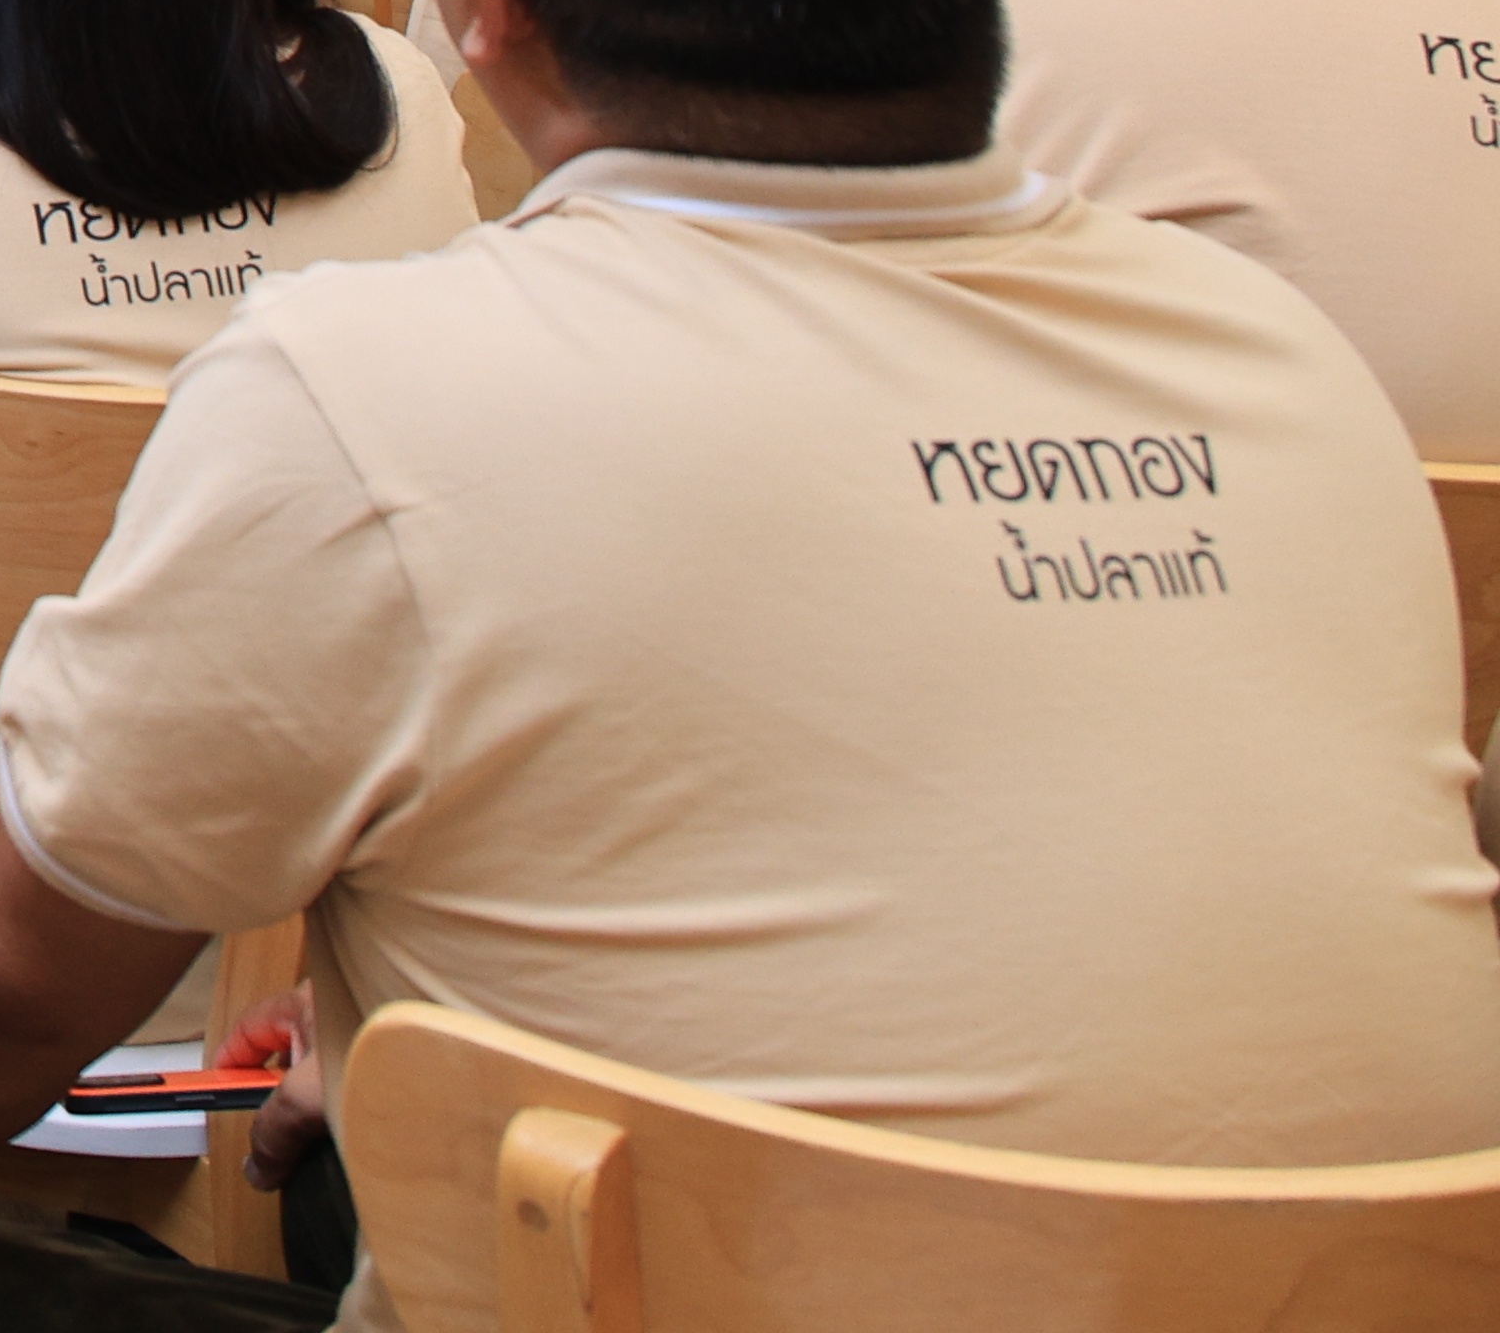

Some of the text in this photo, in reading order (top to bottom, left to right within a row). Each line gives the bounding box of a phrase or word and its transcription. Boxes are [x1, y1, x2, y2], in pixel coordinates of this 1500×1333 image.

[912, 433, 1220, 505] หยดทอง
[996, 521, 1229, 604] น้ำปลาแท้
